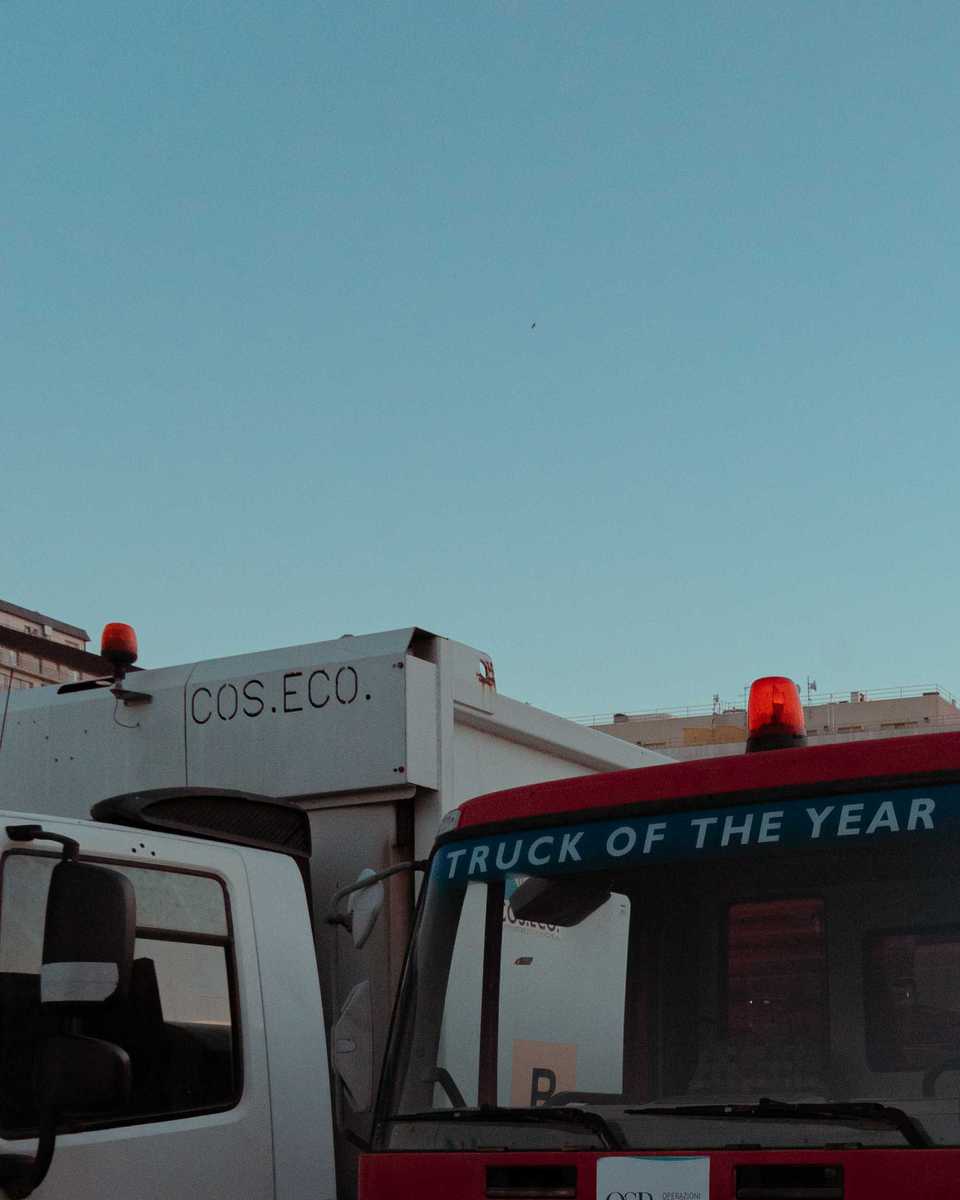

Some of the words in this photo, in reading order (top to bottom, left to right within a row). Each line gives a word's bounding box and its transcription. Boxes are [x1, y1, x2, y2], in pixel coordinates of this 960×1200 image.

[191, 666, 371, 725] COS.ECO.
[446, 831, 585, 880] TRUCK
[605, 822, 668, 858] OF
[690, 810, 785, 850] THE
[804, 798, 936, 840] YEAR
